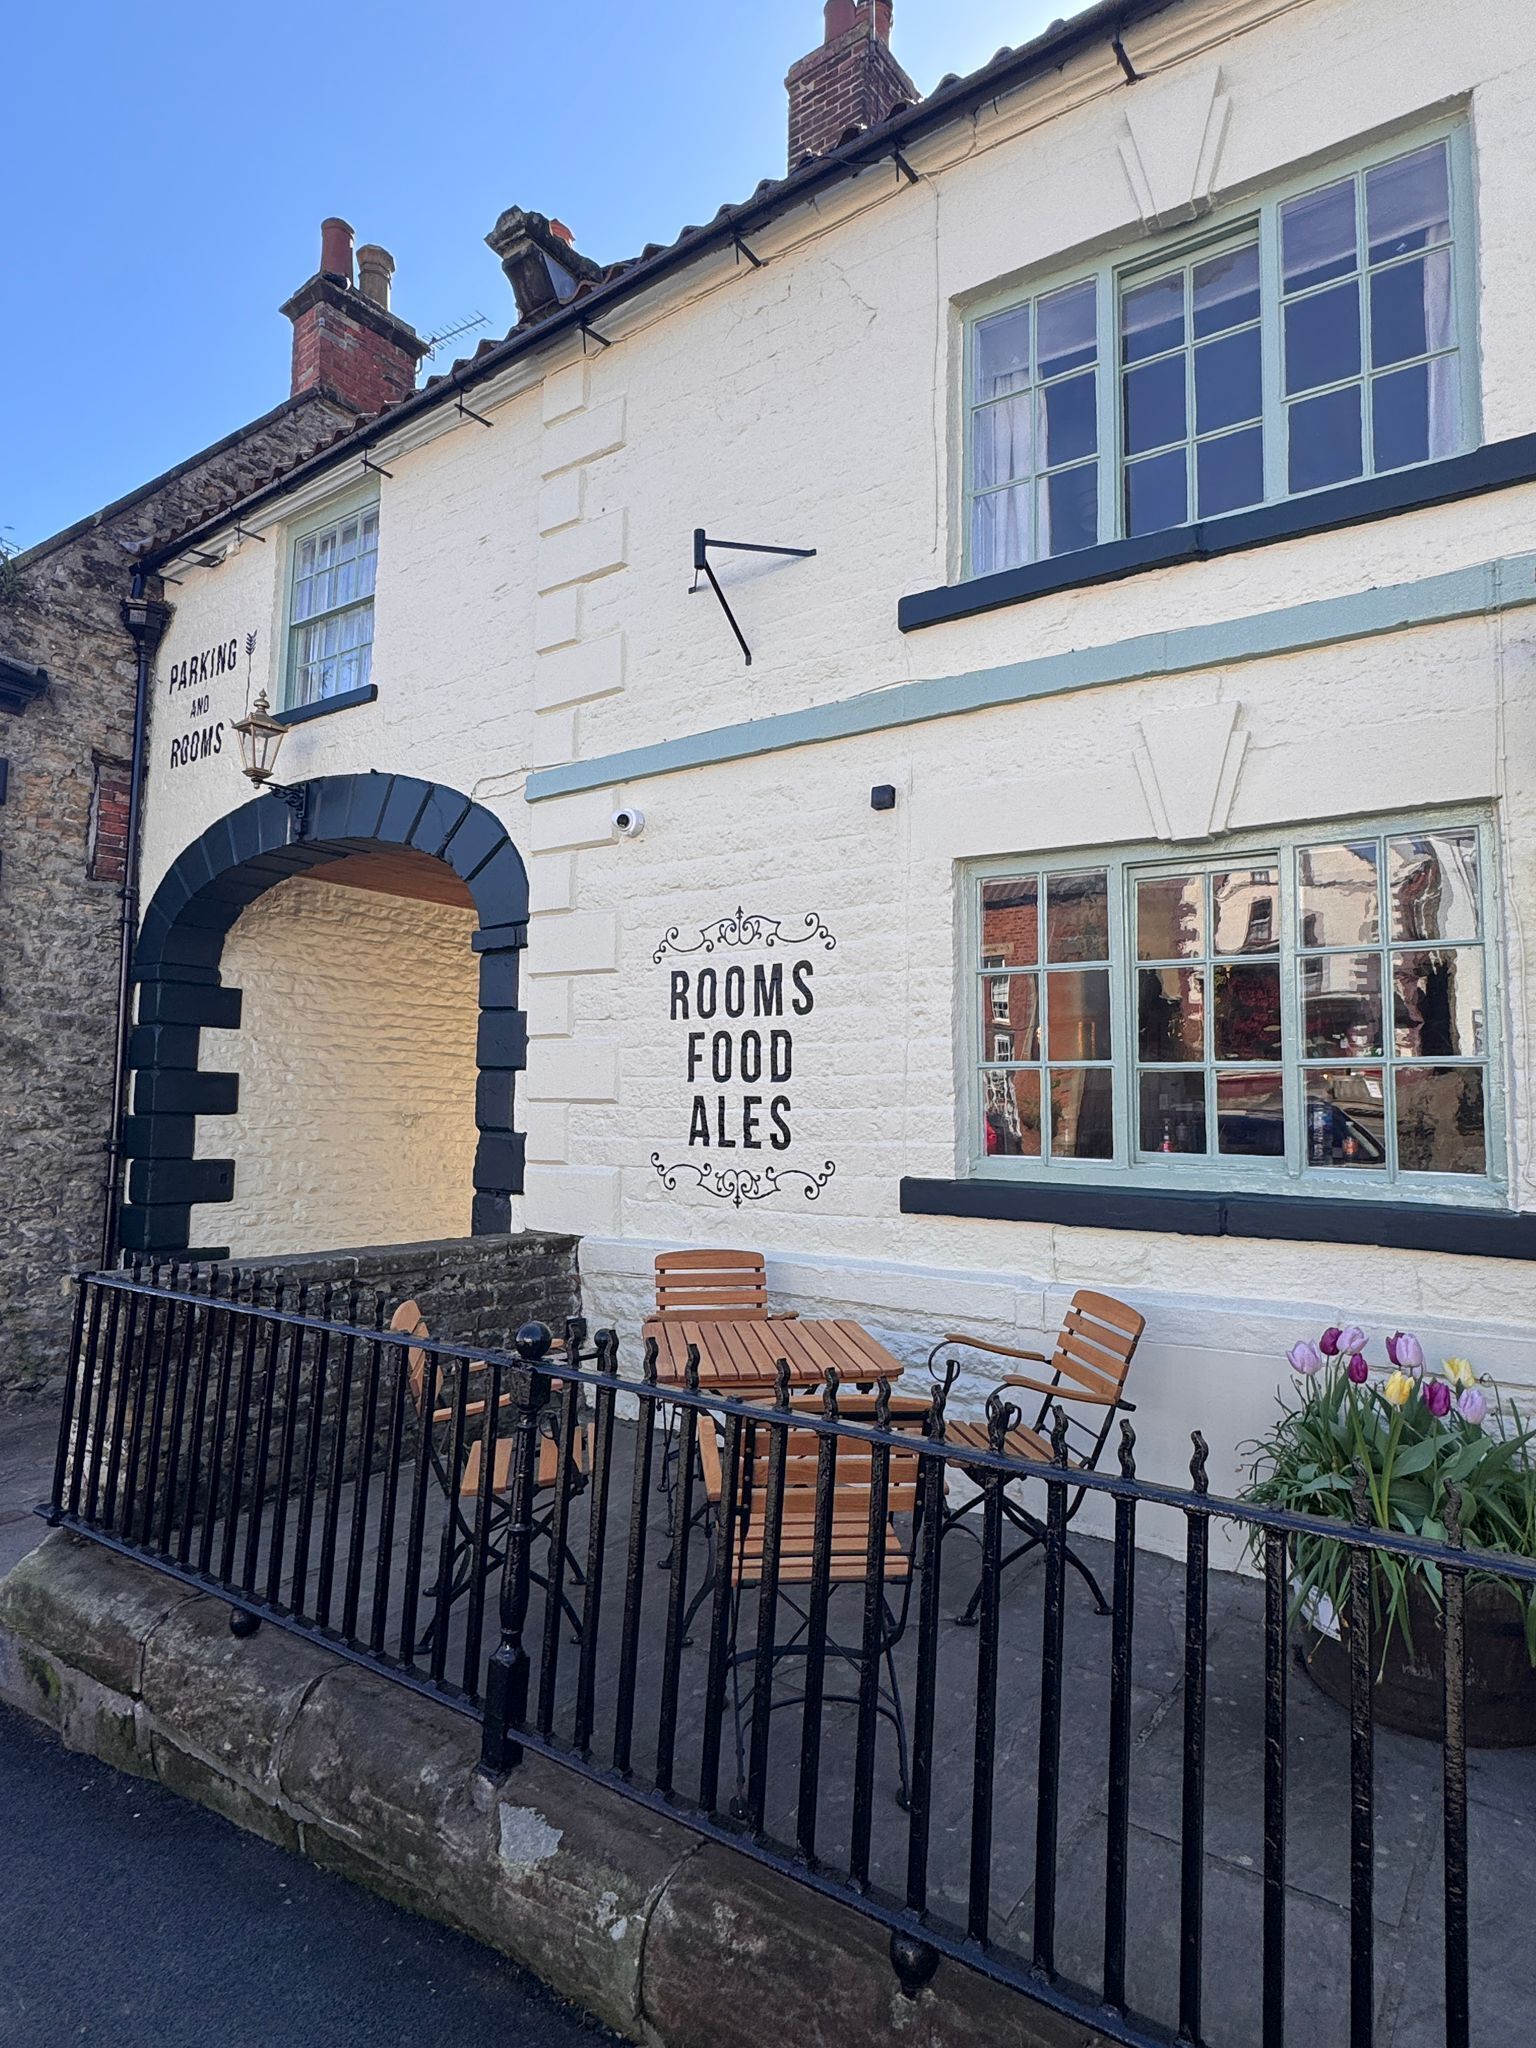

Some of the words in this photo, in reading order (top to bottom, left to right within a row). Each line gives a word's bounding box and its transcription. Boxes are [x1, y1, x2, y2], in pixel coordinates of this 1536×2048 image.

[169, 638, 237, 695] PARKING
[190, 694, 209, 718] AND
[170, 722, 224, 769] ROOMS
[670, 960, 814, 1020] ROOMS
[687, 1029, 793, 1084] FOOD
[688, 1095, 792, 1151] ALES
